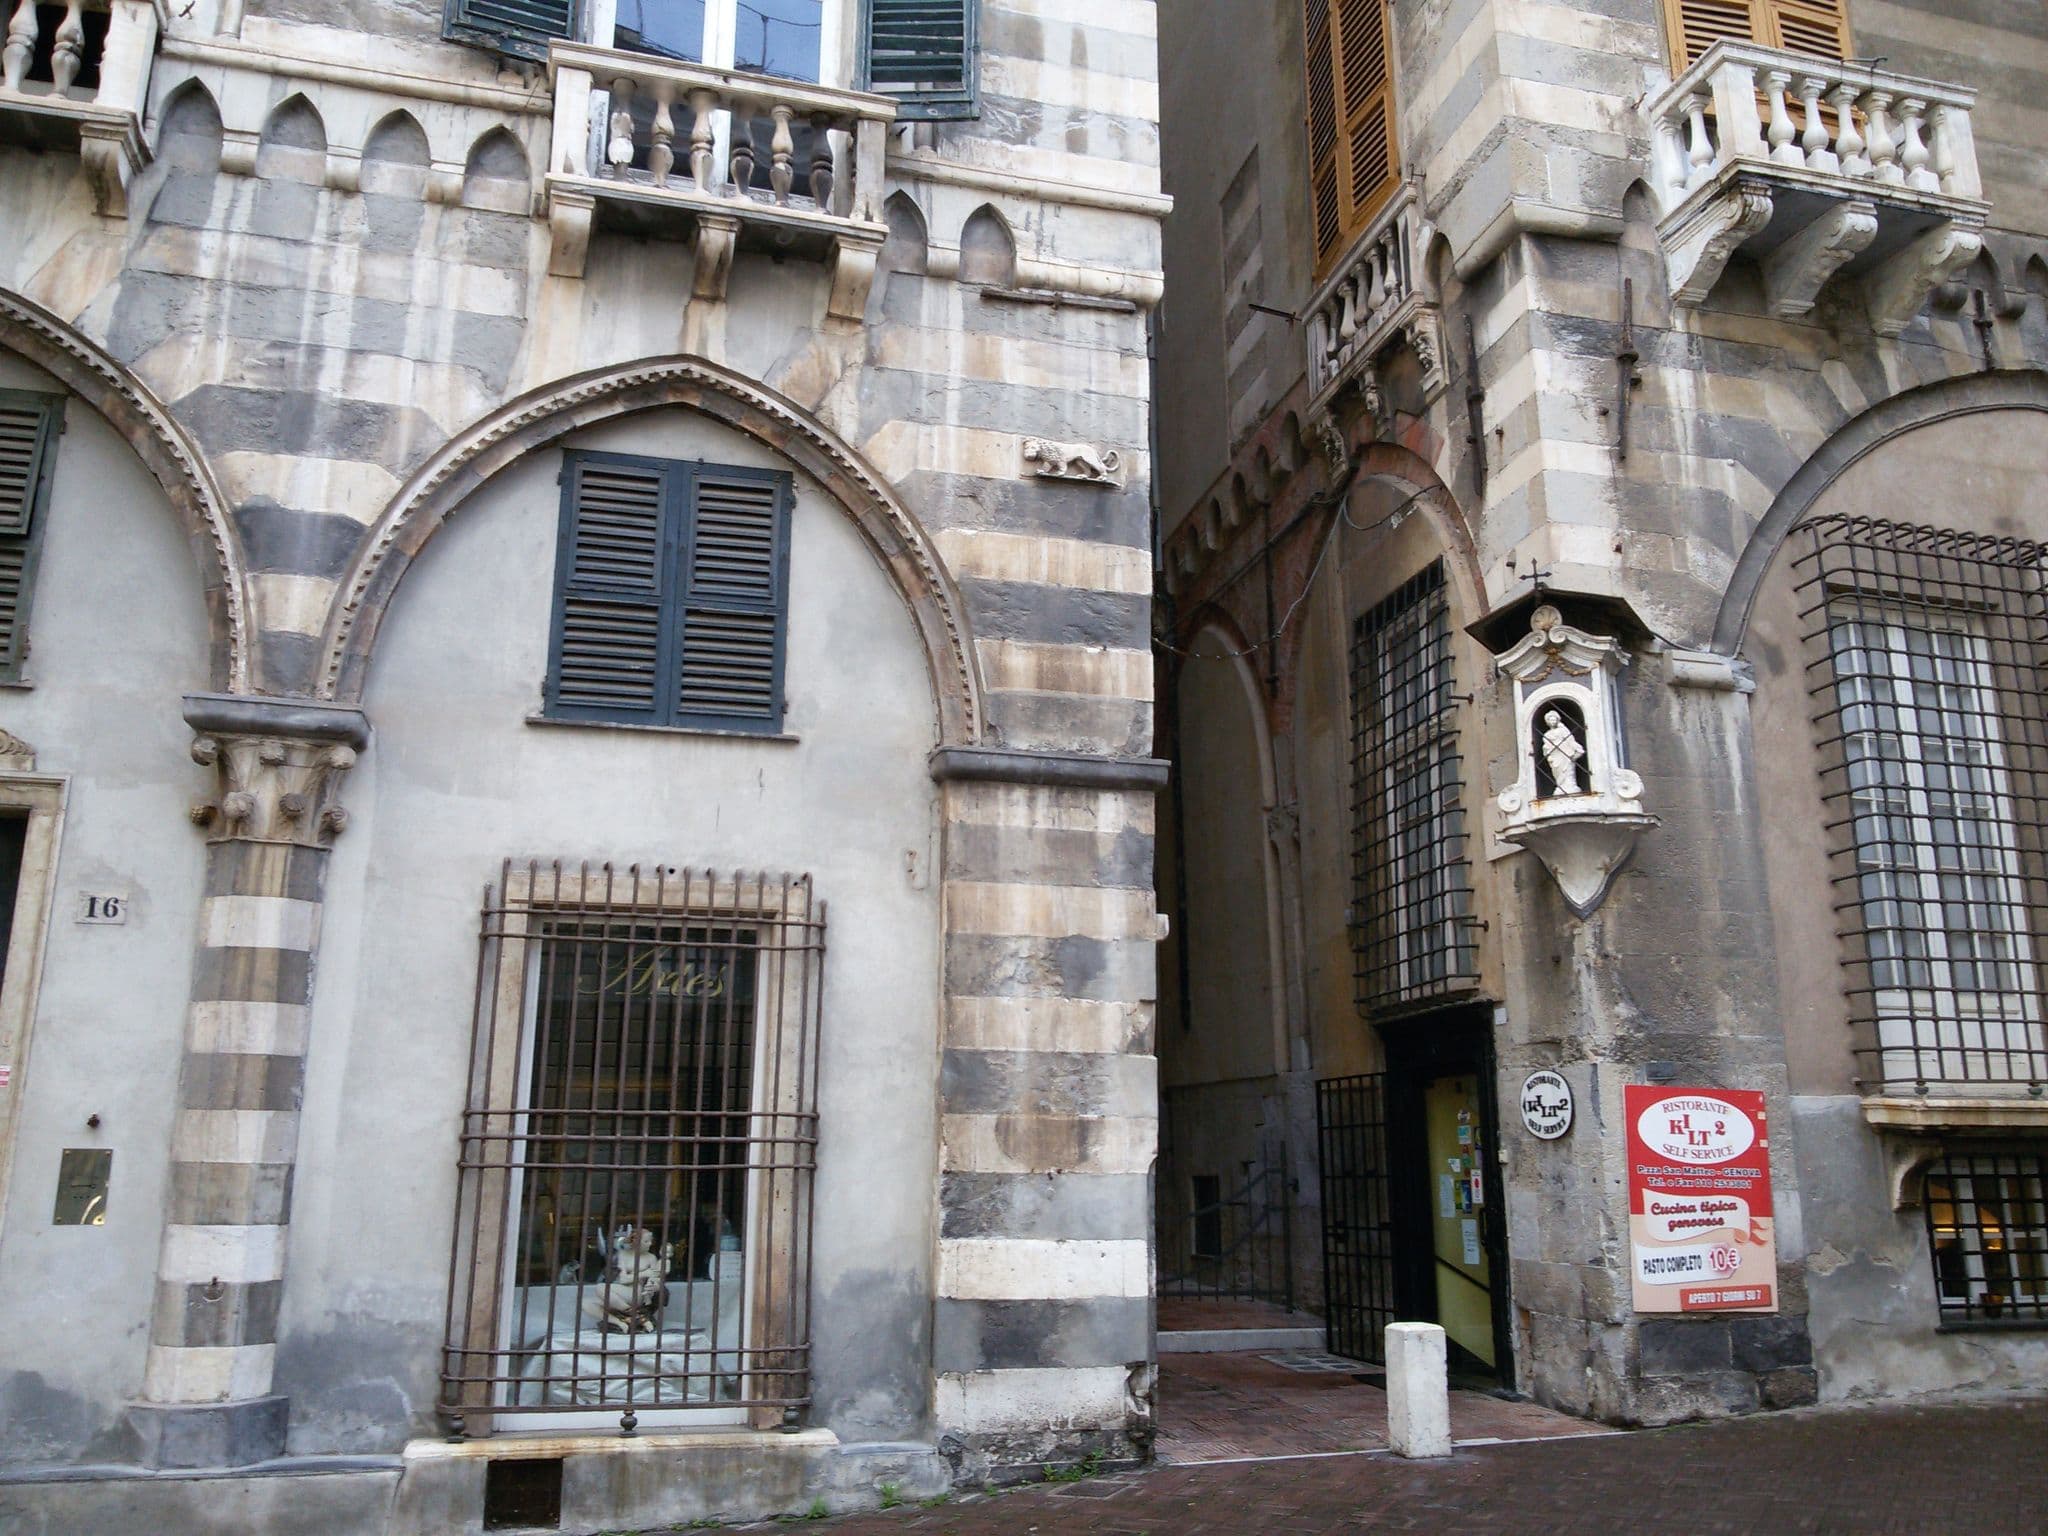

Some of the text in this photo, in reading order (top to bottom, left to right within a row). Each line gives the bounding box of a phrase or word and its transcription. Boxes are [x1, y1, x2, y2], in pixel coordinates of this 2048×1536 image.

[85, 897, 119, 918] 16
[1558, 1098, 1569, 1110] 2
[1662, 1101, 1730, 1115] RISTORANTE
[1714, 1120, 1727, 1136] 2
[1662, 1143, 1735, 1159] SELF SERVICE
[1663, 1166, 1682, 1175] San
[1683, 1166, 1715, 1176] Matteo
[1722, 1168, 1762, 1178] GENOVA
[1651, 1200, 1738, 1216] Cucina tipica
[1668, 1217, 1725, 1232] genovese
[1643, 1258, 1665, 1274] PASTO
[1666, 1254, 1703, 1273] COMPLETO
